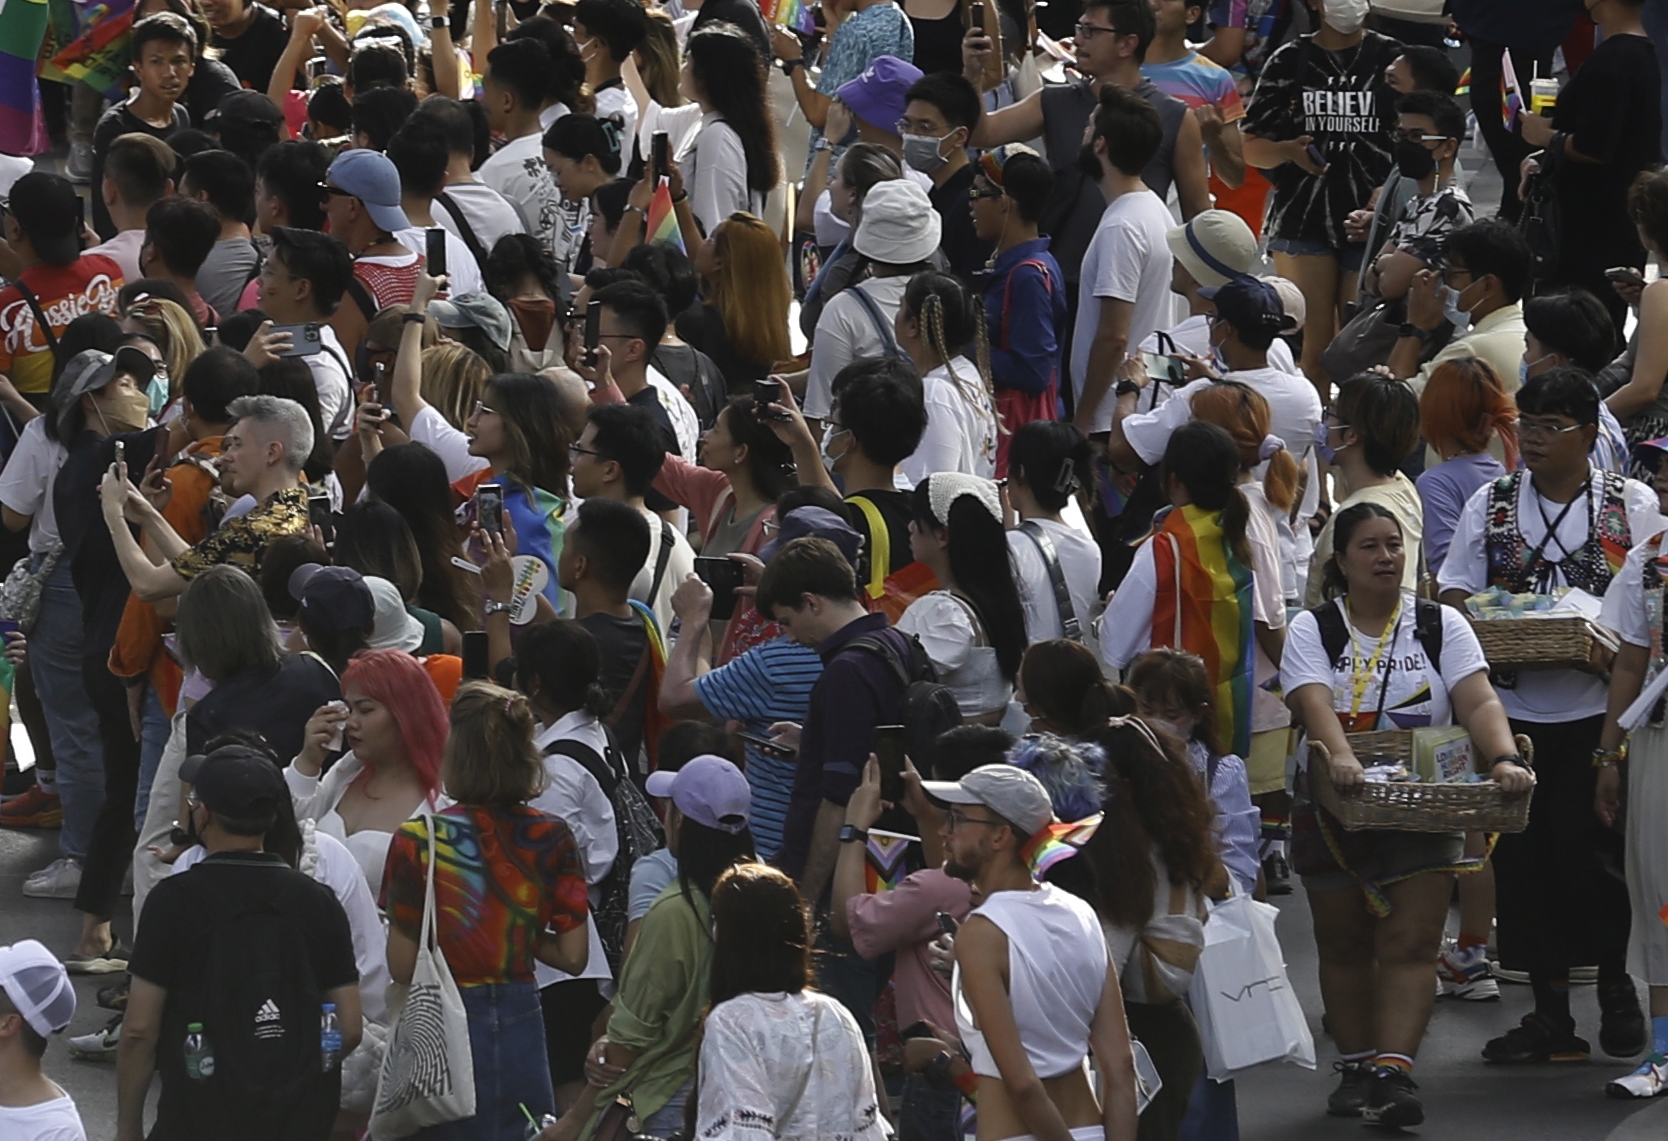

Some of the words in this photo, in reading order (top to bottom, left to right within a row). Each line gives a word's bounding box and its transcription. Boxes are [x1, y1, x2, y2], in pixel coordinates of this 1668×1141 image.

[1305, 116, 1316, 133] IN
[1334, 655, 1371, 674] APPY
[1376, 653, 1427, 675] PRIDE!
